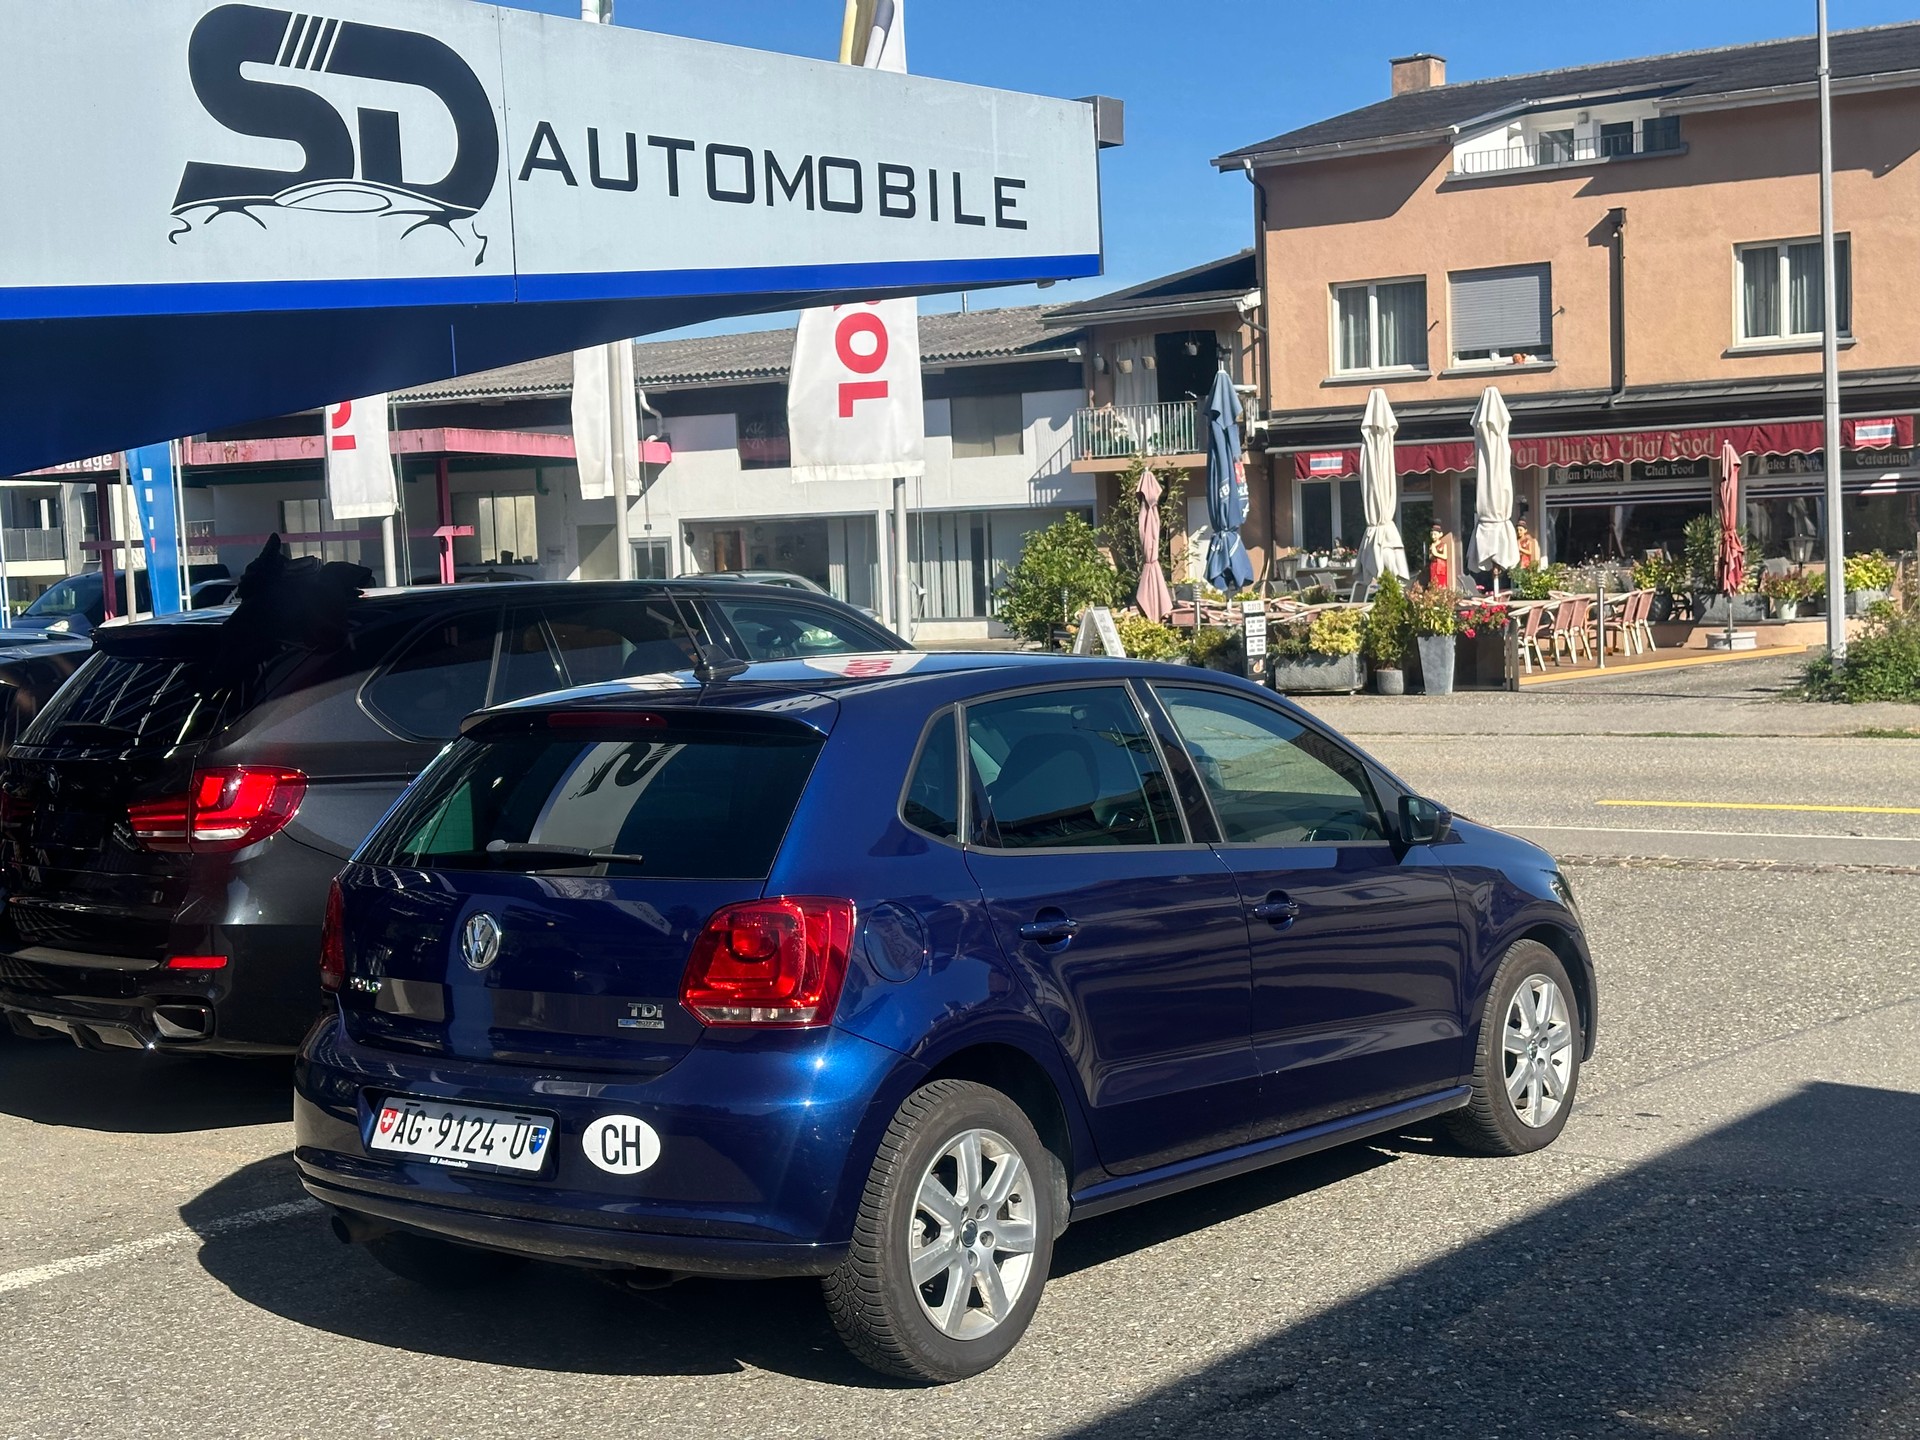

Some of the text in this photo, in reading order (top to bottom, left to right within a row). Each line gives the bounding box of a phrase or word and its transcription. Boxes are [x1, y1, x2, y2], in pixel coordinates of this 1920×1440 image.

[171, 3, 1028, 230] SD AUTOMOBILE
[834, 301, 889, 418] OL
[1669, 432, 1715, 455] Food
[601, 1124, 641, 1167] CH
